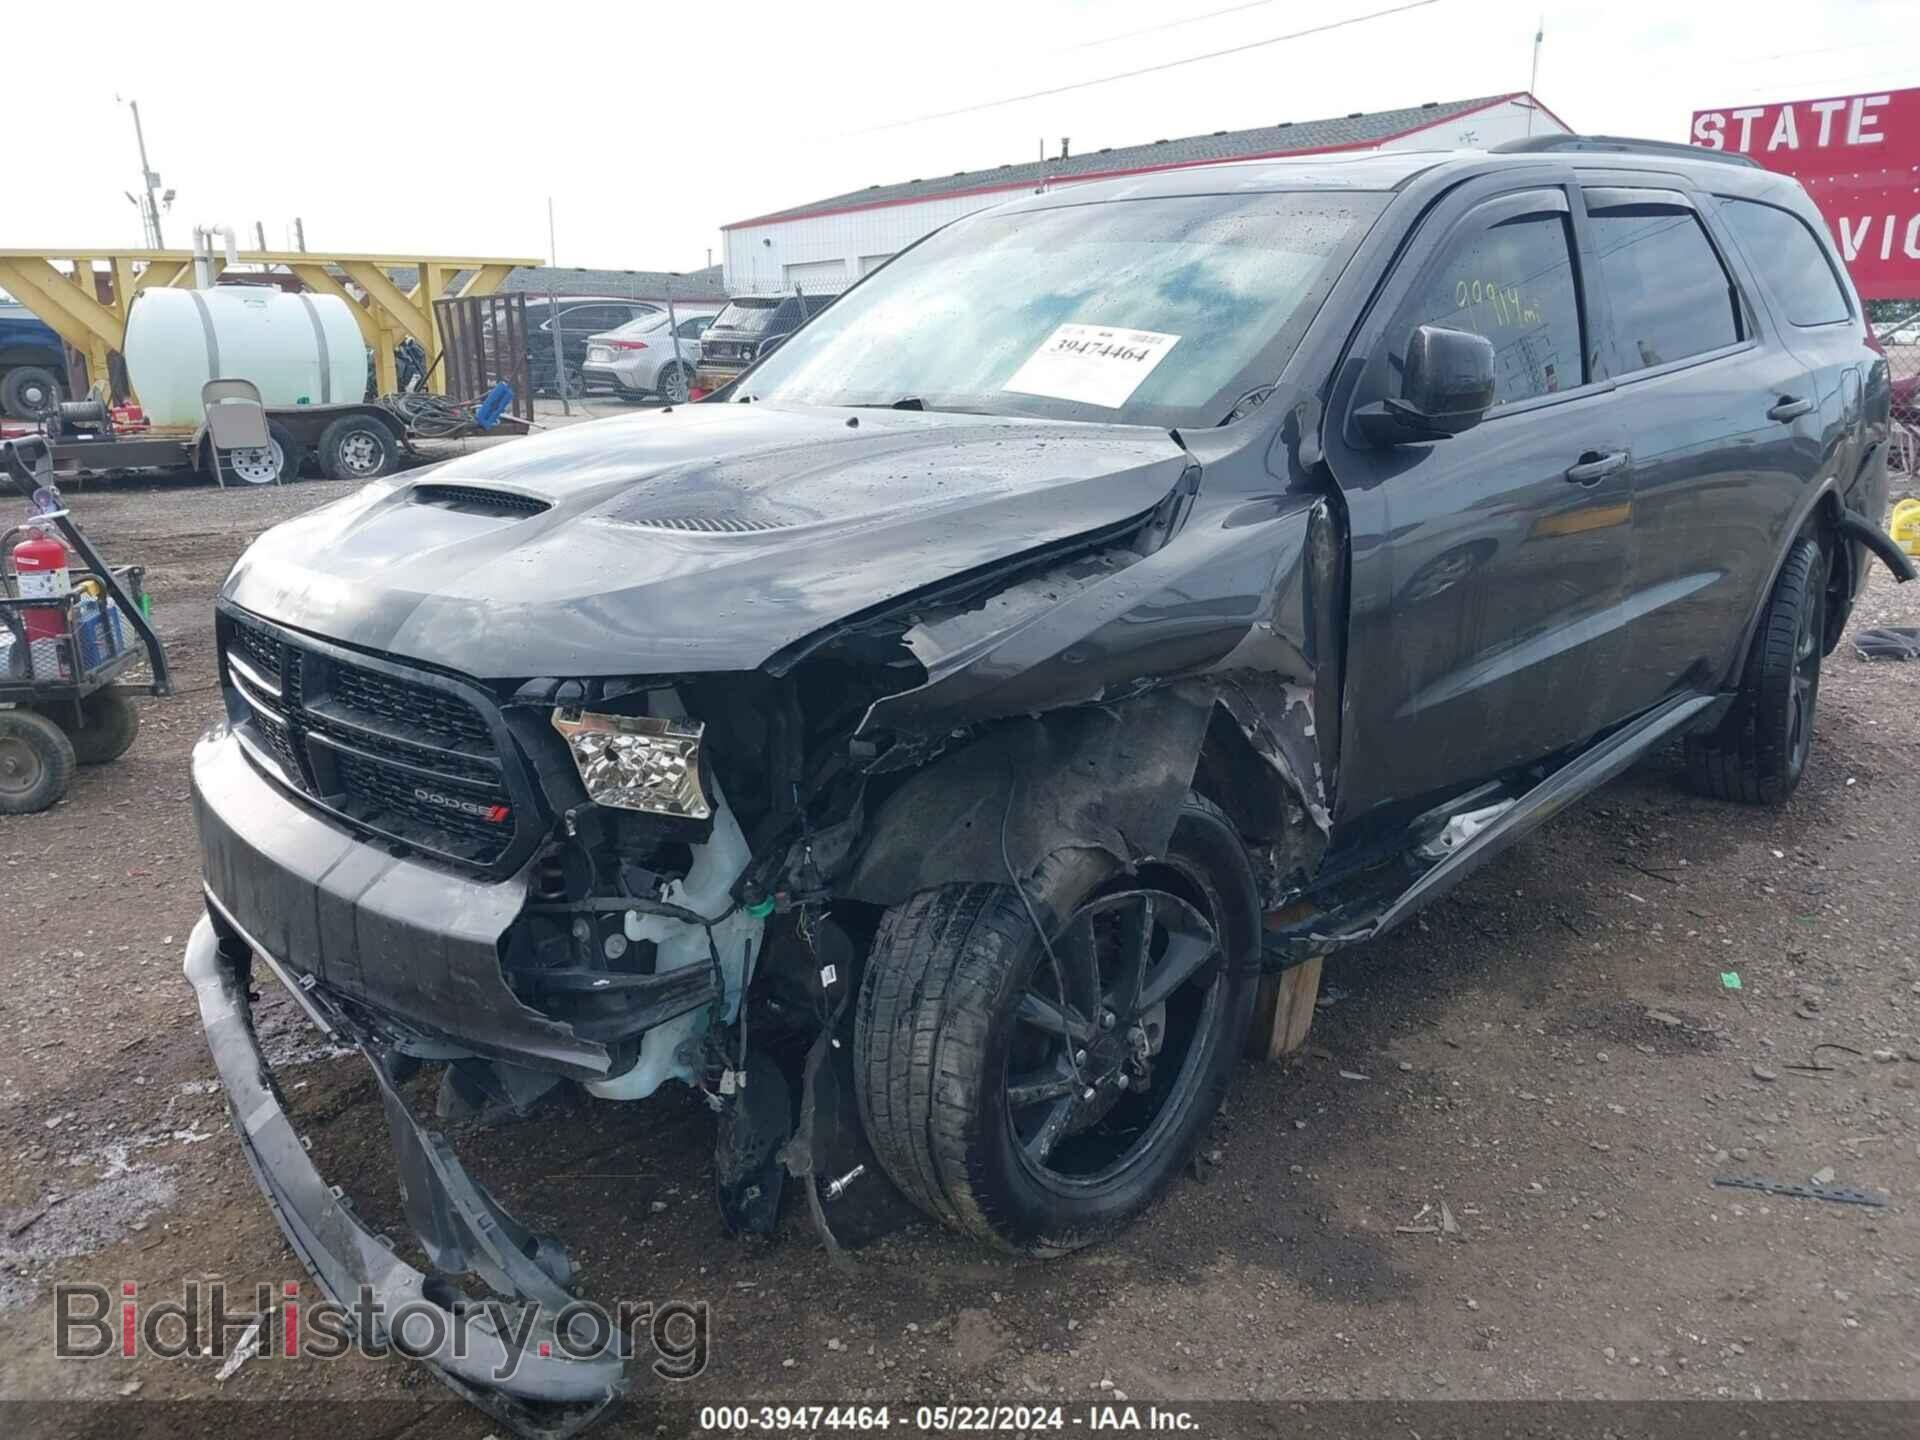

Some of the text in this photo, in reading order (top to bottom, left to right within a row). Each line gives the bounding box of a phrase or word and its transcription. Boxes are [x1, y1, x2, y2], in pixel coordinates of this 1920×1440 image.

[1693, 95, 1890, 152] STATE
[1051, 339, 1150, 362] 39474464
[415, 788, 497, 817] DODGE
